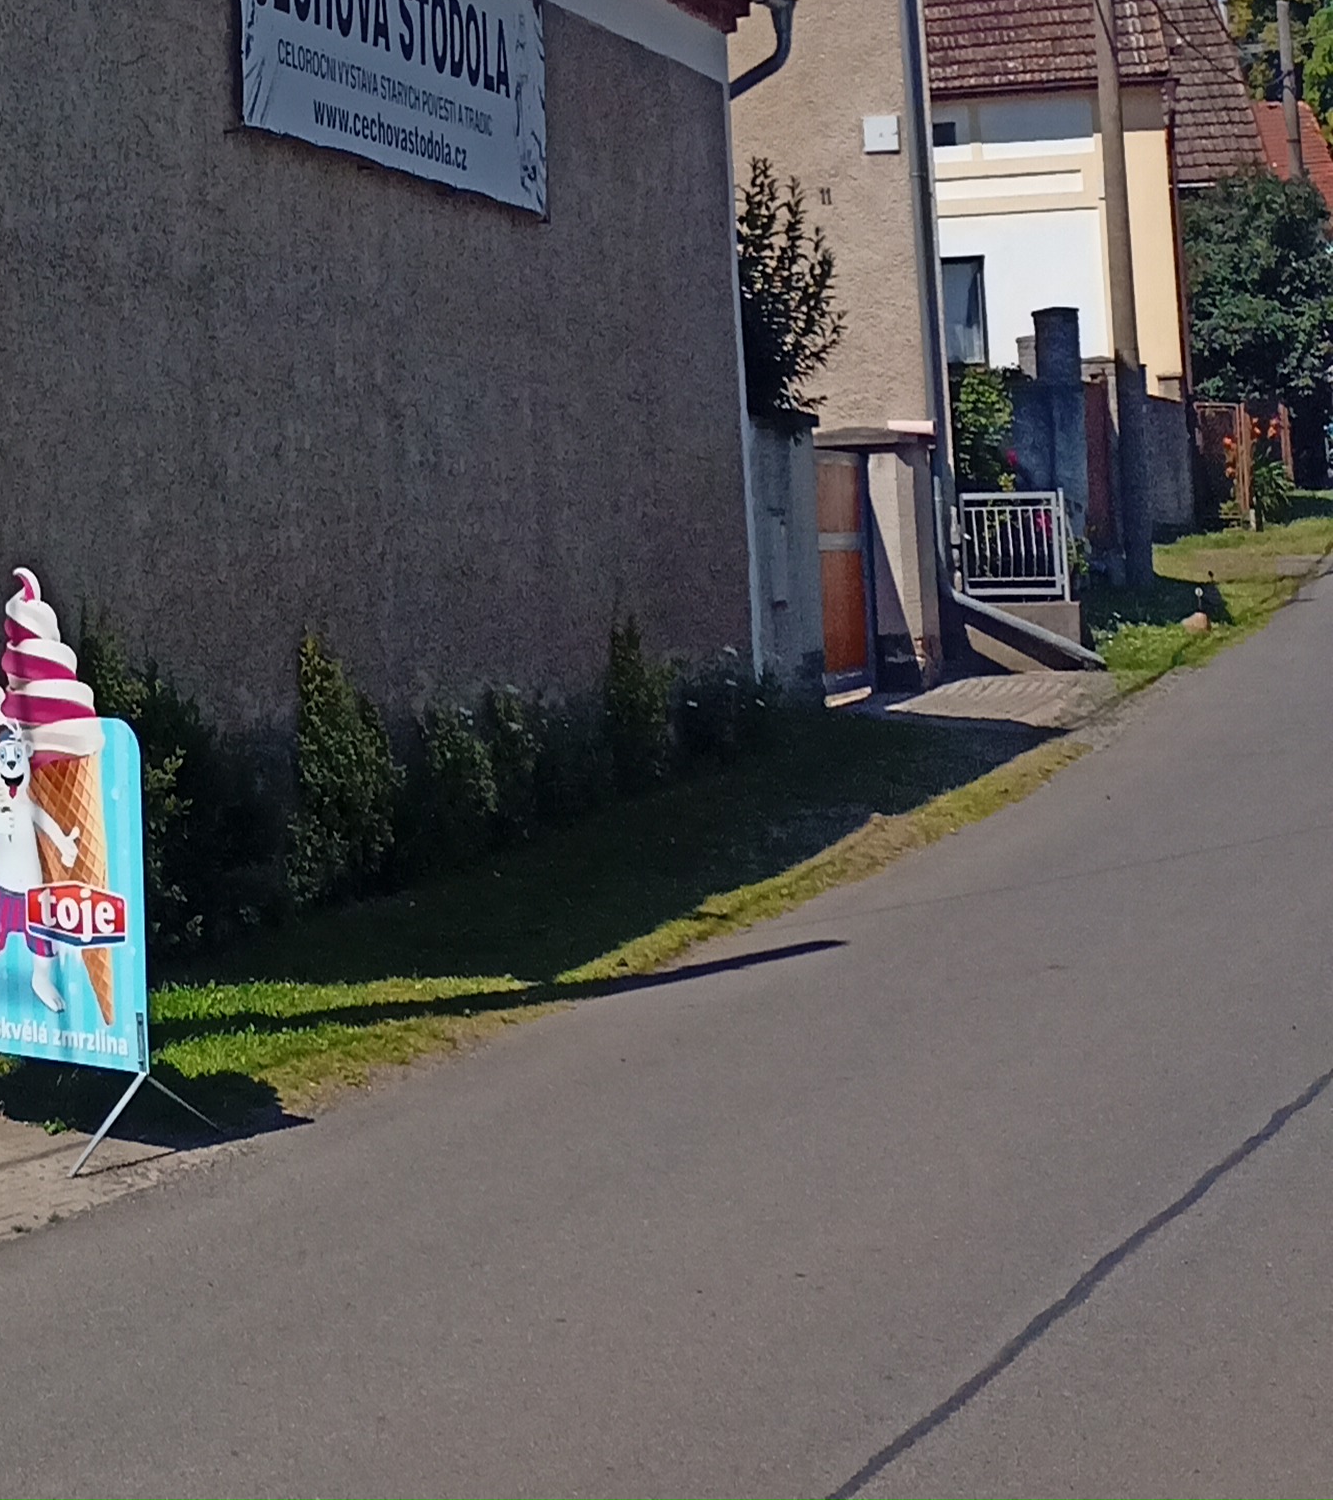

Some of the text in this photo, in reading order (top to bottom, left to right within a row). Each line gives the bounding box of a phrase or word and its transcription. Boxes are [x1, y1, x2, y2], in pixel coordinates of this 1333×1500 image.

[313, 99, 468, 171] www.cechovastodola.cz
[457, 103, 463, 126] A
[38, 888, 116, 943] toje
[52, 1028, 129, 1056] zmrzlina
